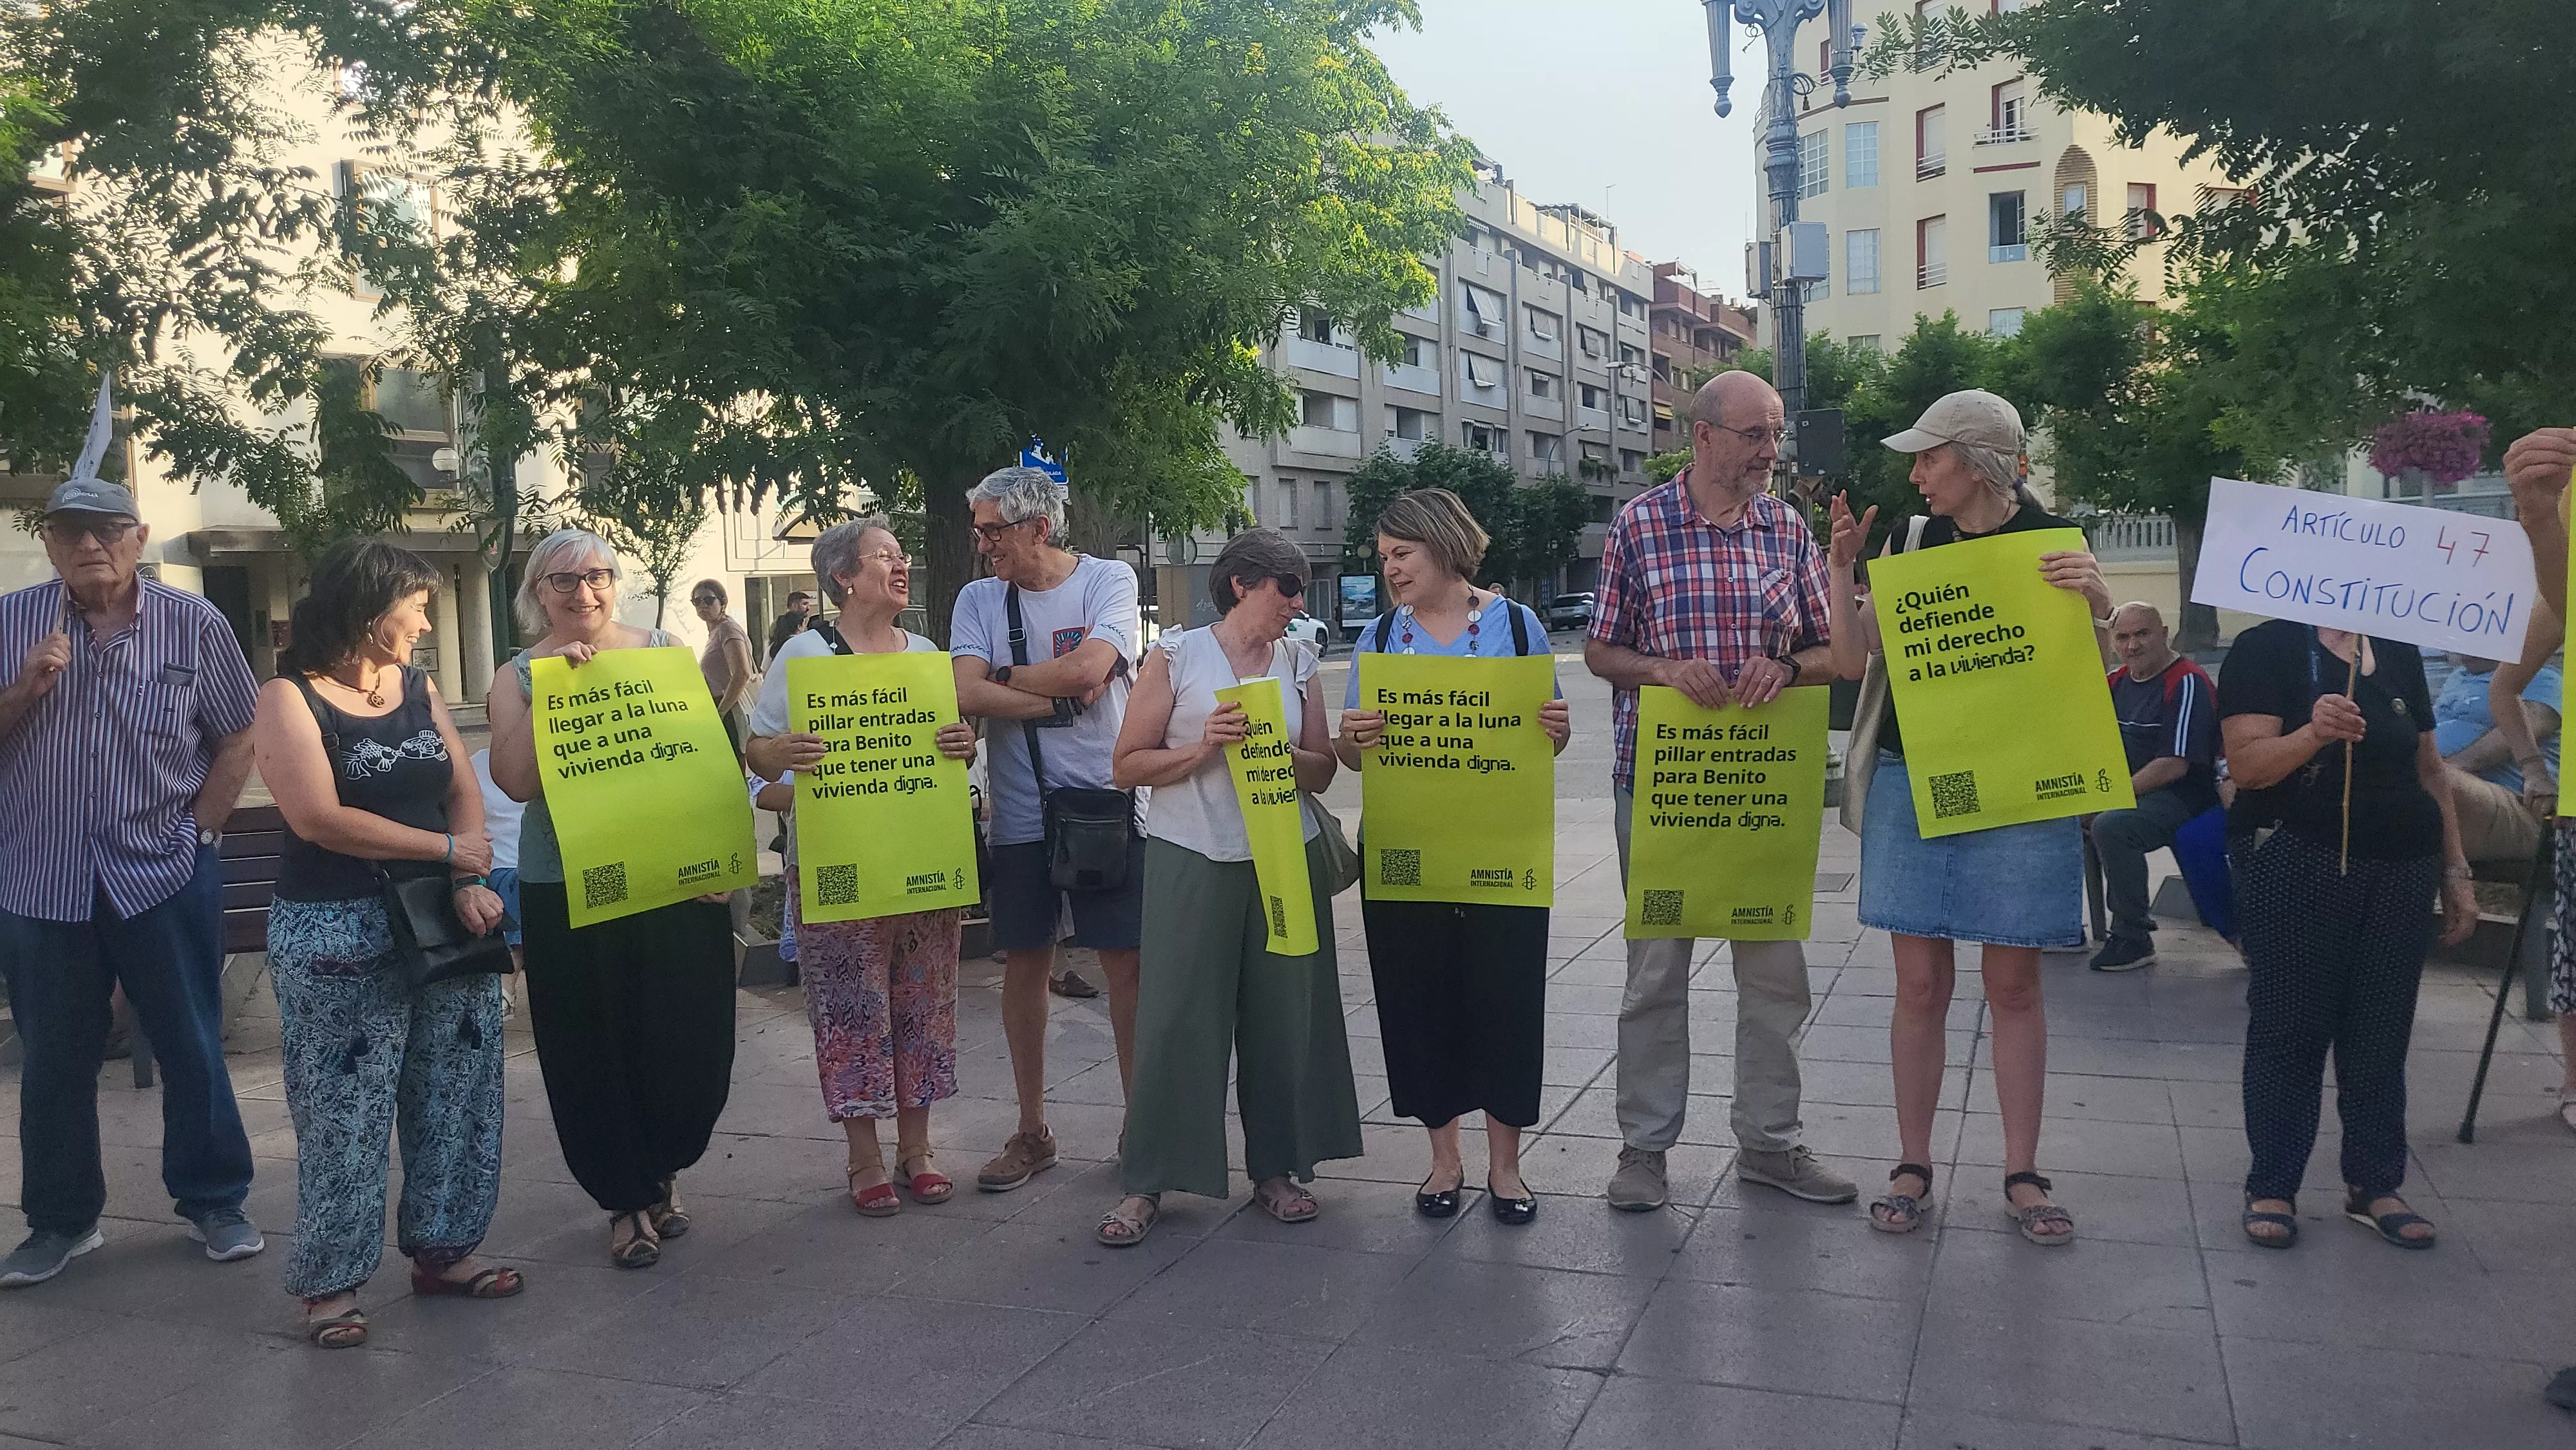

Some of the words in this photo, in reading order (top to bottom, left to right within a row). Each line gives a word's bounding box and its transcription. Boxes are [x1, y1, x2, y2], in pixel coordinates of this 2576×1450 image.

[2281, 505, 2405, 548] ARTÍCULO
[2437, 525, 2490, 567] 47
[1896, 583, 1969, 614] ¿Quién
[1900, 603, 1994, 633] defiende
[1904, 637, 1931, 657] mi
[1938, 624, 2025, 651] derecho
[1910, 669, 1921, 681] a
[1927, 662, 1946, 678] la
[1951, 645, 2034, 674] vivienda?
[549, 695, 564, 710] Es
[569, 687, 610, 707] más
[614, 680, 654, 697] fácil
[808, 693, 826, 708] Es
[831, 690, 867, 707] más
[872, 688, 907, 704] fácil
[1378, 689, 1397, 703] Es
[1403, 690, 1443, 705] más
[1448, 691, 1489, 706] fácil
[549, 713, 604, 734] llegar
[611, 710, 622, 721] a
[627, 703, 645, 718] la
[649, 700, 688, 713] luna
[809, 714, 854, 733] pillar
[860, 709, 935, 727] entradas
[1378, 710, 1434, 729] legar
[1439, 716, 1449, 726] a
[1457, 713, 1472, 728] la
[1479, 713, 1520, 728] luna
[1242, 719, 1273, 739] Quién
[1657, 724, 1676, 739] Es
[1683, 724, 1723, 740] más
[1729, 724, 1768, 740] fácil
[554, 740, 591, 760] que
[598, 736, 609, 748] a
[614, 727, 652, 743] una
[822, 740, 850, 753] ara
[856, 733, 911, 750] Benito
[1241, 740, 1291, 760] defiende
[1379, 735, 1414, 749] que
[1421, 736, 1430, 746] a
[1437, 737, 1473, 749] una
[558, 749, 645, 778] vivienda
[650, 742, 698, 761] digna.
[1378, 752, 1459, 768] vivienda
[1467, 755, 1515, 773] digna.
[1655, 746, 1705, 765] pillar
[1711, 747, 1796, 762] entradas
[812, 763, 845, 780] que
[850, 758, 897, 773] tener
[903, 755, 934, 768] una
[1246, 766, 1260, 782] mi
[1261, 765, 1294, 782] derec
[812, 778, 888, 798] vivienda
[894, 775, 937, 795] digna.
[1653, 772, 1696, 787] para
[1704, 769, 1766, 784] Benito
[2036, 772, 2085, 792] AMNISTÍA
[1252, 793, 1259, 804] a
[1260, 789, 1267, 804] la
[1267, 787, 1298, 805] vivien
[1652, 793, 1688, 809] que
[1694, 793, 1747, 805] tener
[1752, 794, 1786, 805] una
[1650, 812, 1730, 827] vivienda
[1738, 811, 1785, 831] digna.
[679, 858, 720, 876] AMNISTÍA
[1471, 868, 1513, 880] AMNISTÍA
[679, 871, 721, 885] INTERNACIONAL
[907, 871, 945, 886] AMNISTÍA
[907, 884, 946, 894] INTERNACIONAL
[1732, 905, 1773, 917] AMNISTÍA
